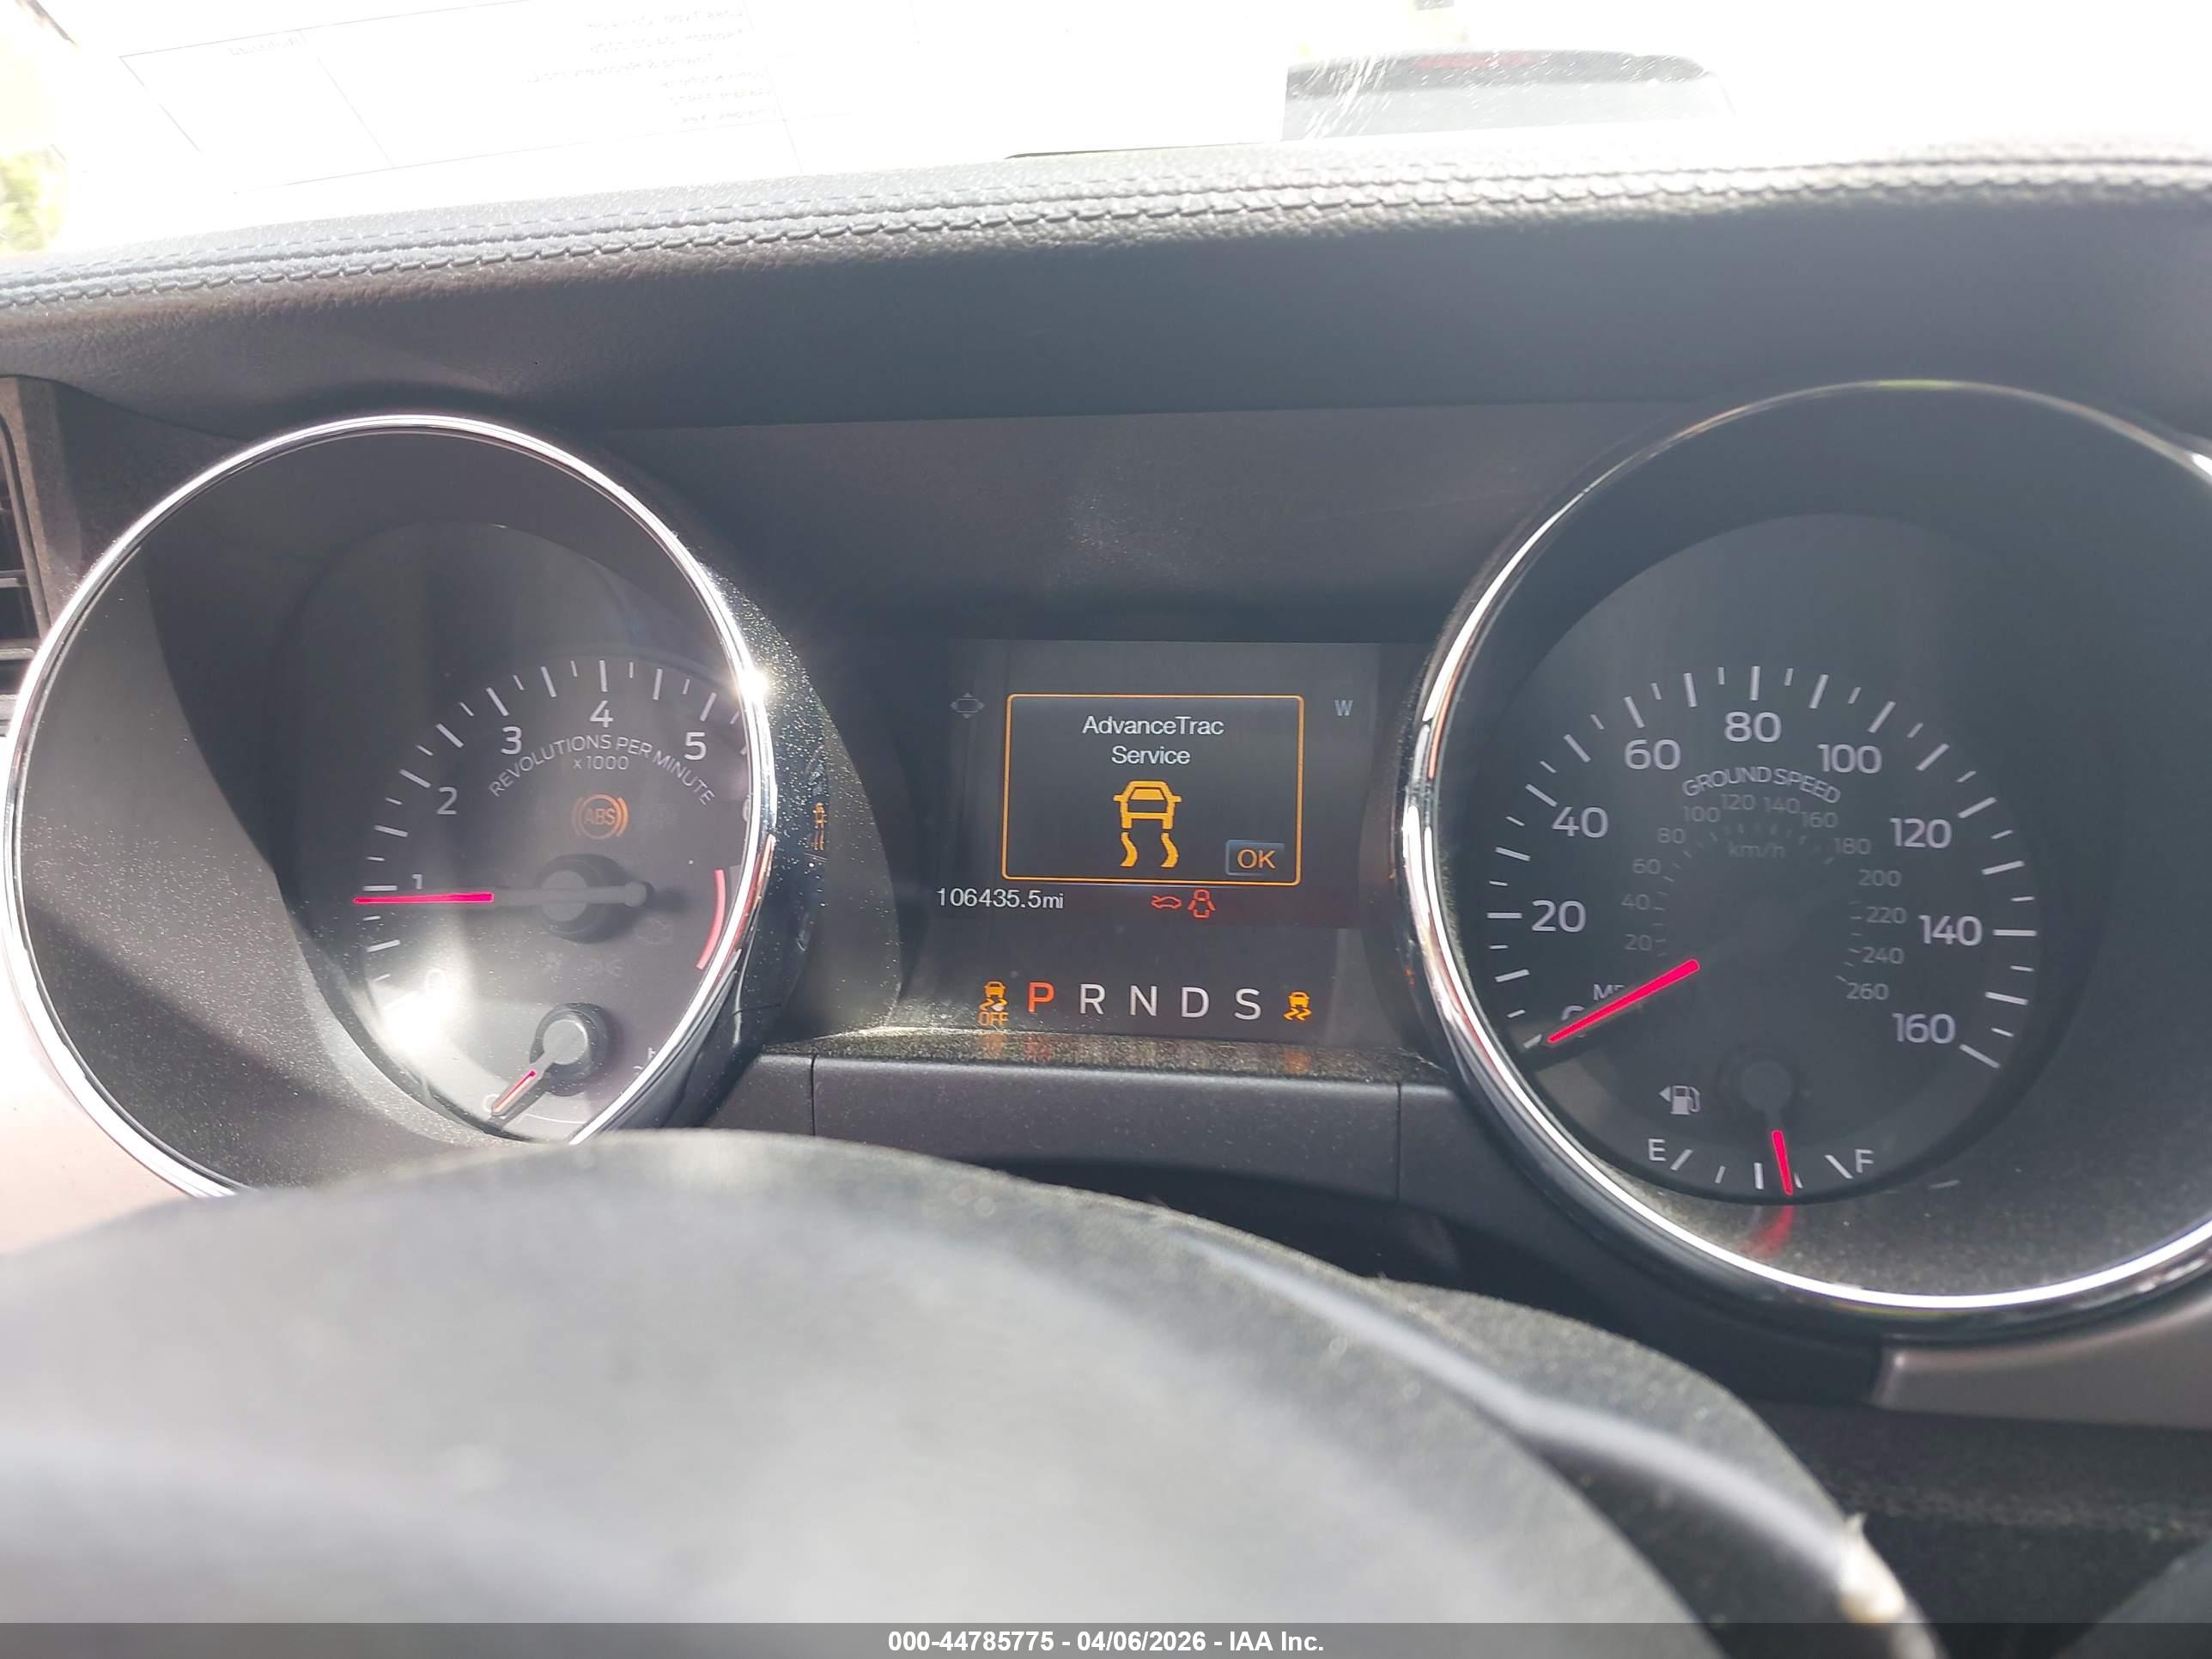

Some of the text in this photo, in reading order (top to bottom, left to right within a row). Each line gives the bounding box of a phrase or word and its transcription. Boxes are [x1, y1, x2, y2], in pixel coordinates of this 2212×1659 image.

[590, 701, 613, 727] 4
[1334, 700, 1353, 716] W
[1083, 716, 1224, 734] AdvanceTrac
[1725, 712, 1781, 742] 80
[501, 726, 521, 754] 3
[684, 732, 706, 760] 5
[1112, 746, 1190, 763] Service
[1626, 739, 1680, 769] 60
[1818, 744, 1881, 774] 100
[489, 733, 715, 805] REVOLUTIONS PER MINUTE
[437, 787, 457, 814] 2
[1721, 793, 1756, 811] 120
[1763, 797, 1801, 814] 140
[584, 809, 616, 823] ABS
[1552, 807, 1608, 837] 40
[1683, 805, 1720, 823] 100
[1802, 811, 1838, 829] 160
[1657, 828, 1686, 843] 80
[1890, 818, 1951, 848] 120
[1728, 841, 1786, 860] km/h
[1834, 838, 1871, 854] 180
[1237, 849, 1275, 868] OK
[1632, 859, 1661, 874] 60
[1858, 869, 1901, 886] 200
[1621, 894, 1650, 910] 40
[1532, 900, 1585, 932] 20
[1866, 906, 1906, 924] 220
[1919, 915, 1982, 945] 140
[1625, 934, 1652, 951] 20
[1862, 946, 1904, 964] 240
[1846, 982, 1888, 1000] 260
[1029, 982, 1261, 1019] P R N D S
[978, 1012, 1009, 1026] OFF
[1893, 1013, 1955, 1043] 160
[1649, 1139, 1666, 1161] E
[1855, 1149, 1873, 1173] F
